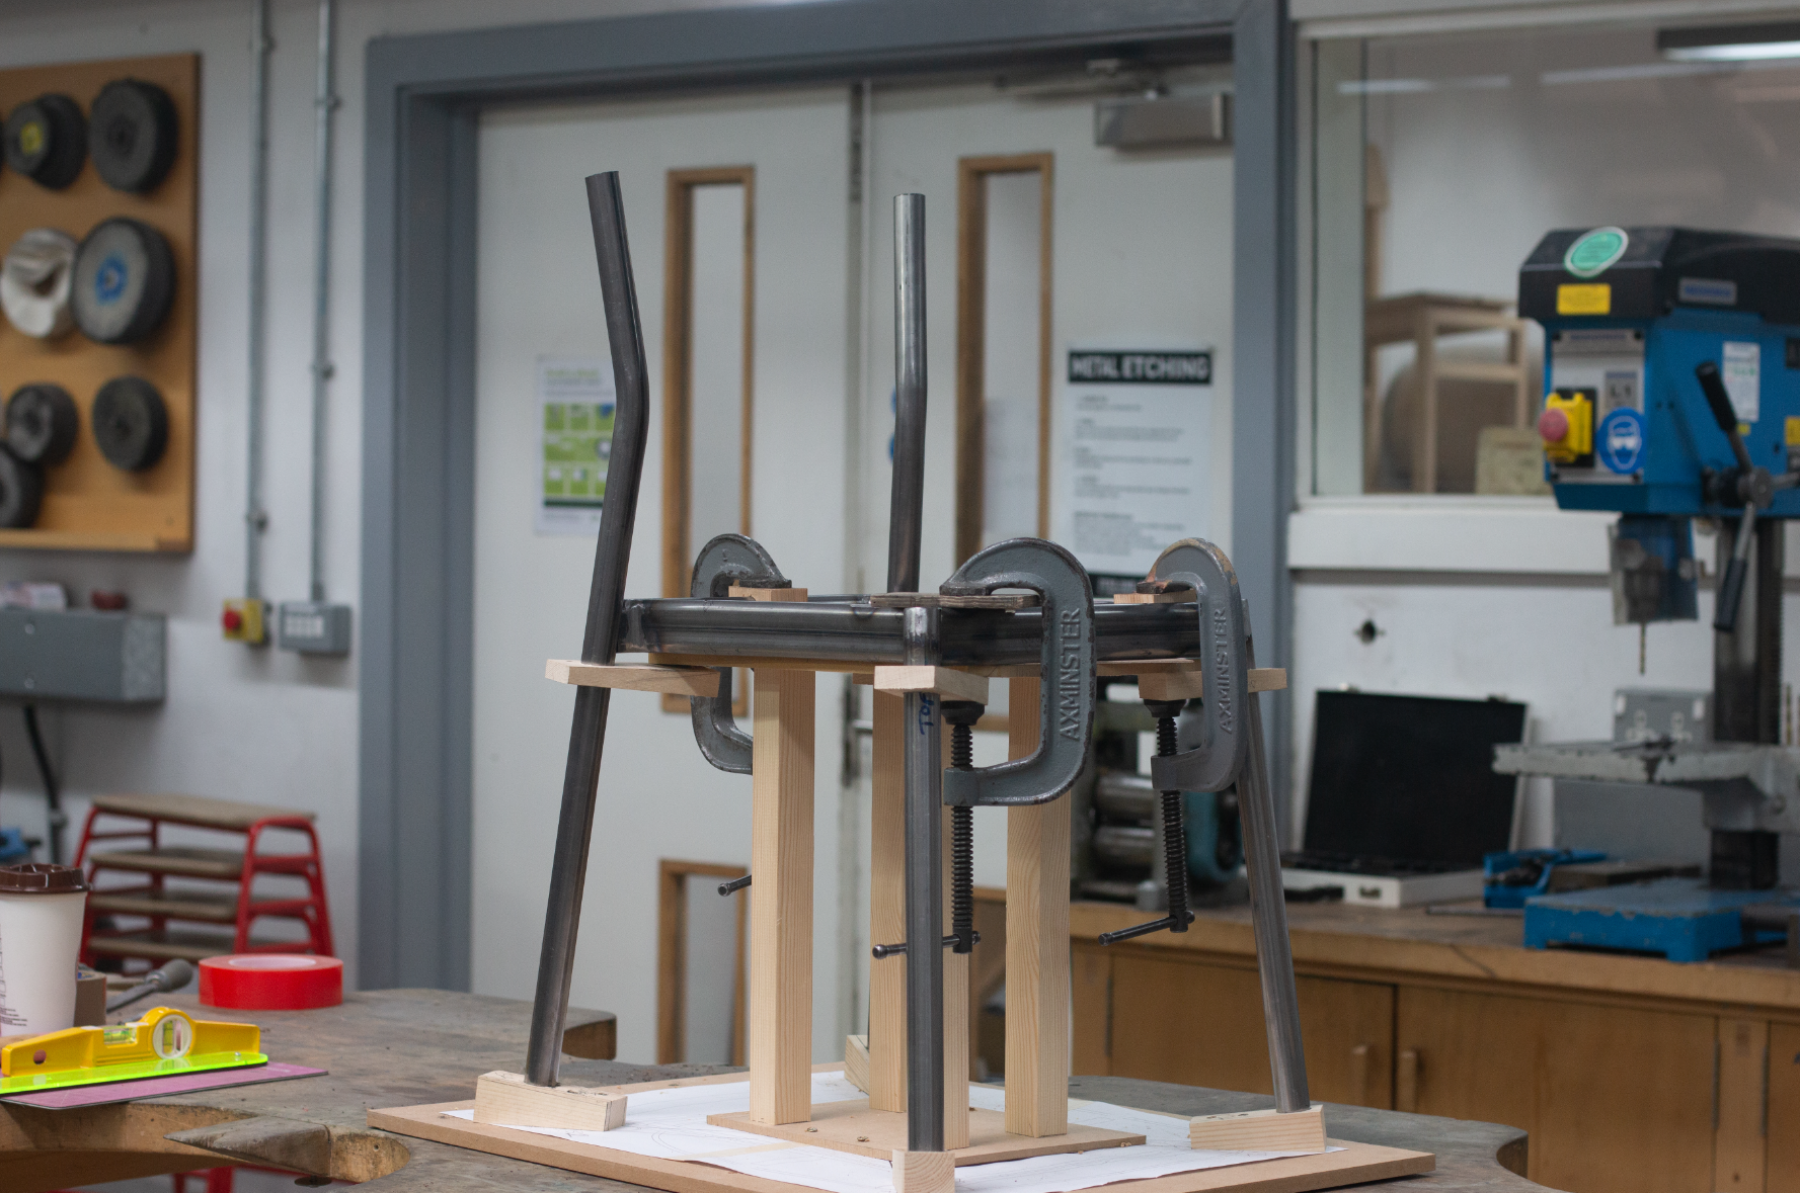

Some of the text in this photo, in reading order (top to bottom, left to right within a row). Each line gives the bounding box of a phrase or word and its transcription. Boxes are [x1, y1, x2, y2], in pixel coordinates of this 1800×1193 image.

[1122, 356, 1208, 380] ETCHING
[1060, 607, 1081, 742] AXMINSTER
[1214, 606, 1232, 734] AXMINSTER
